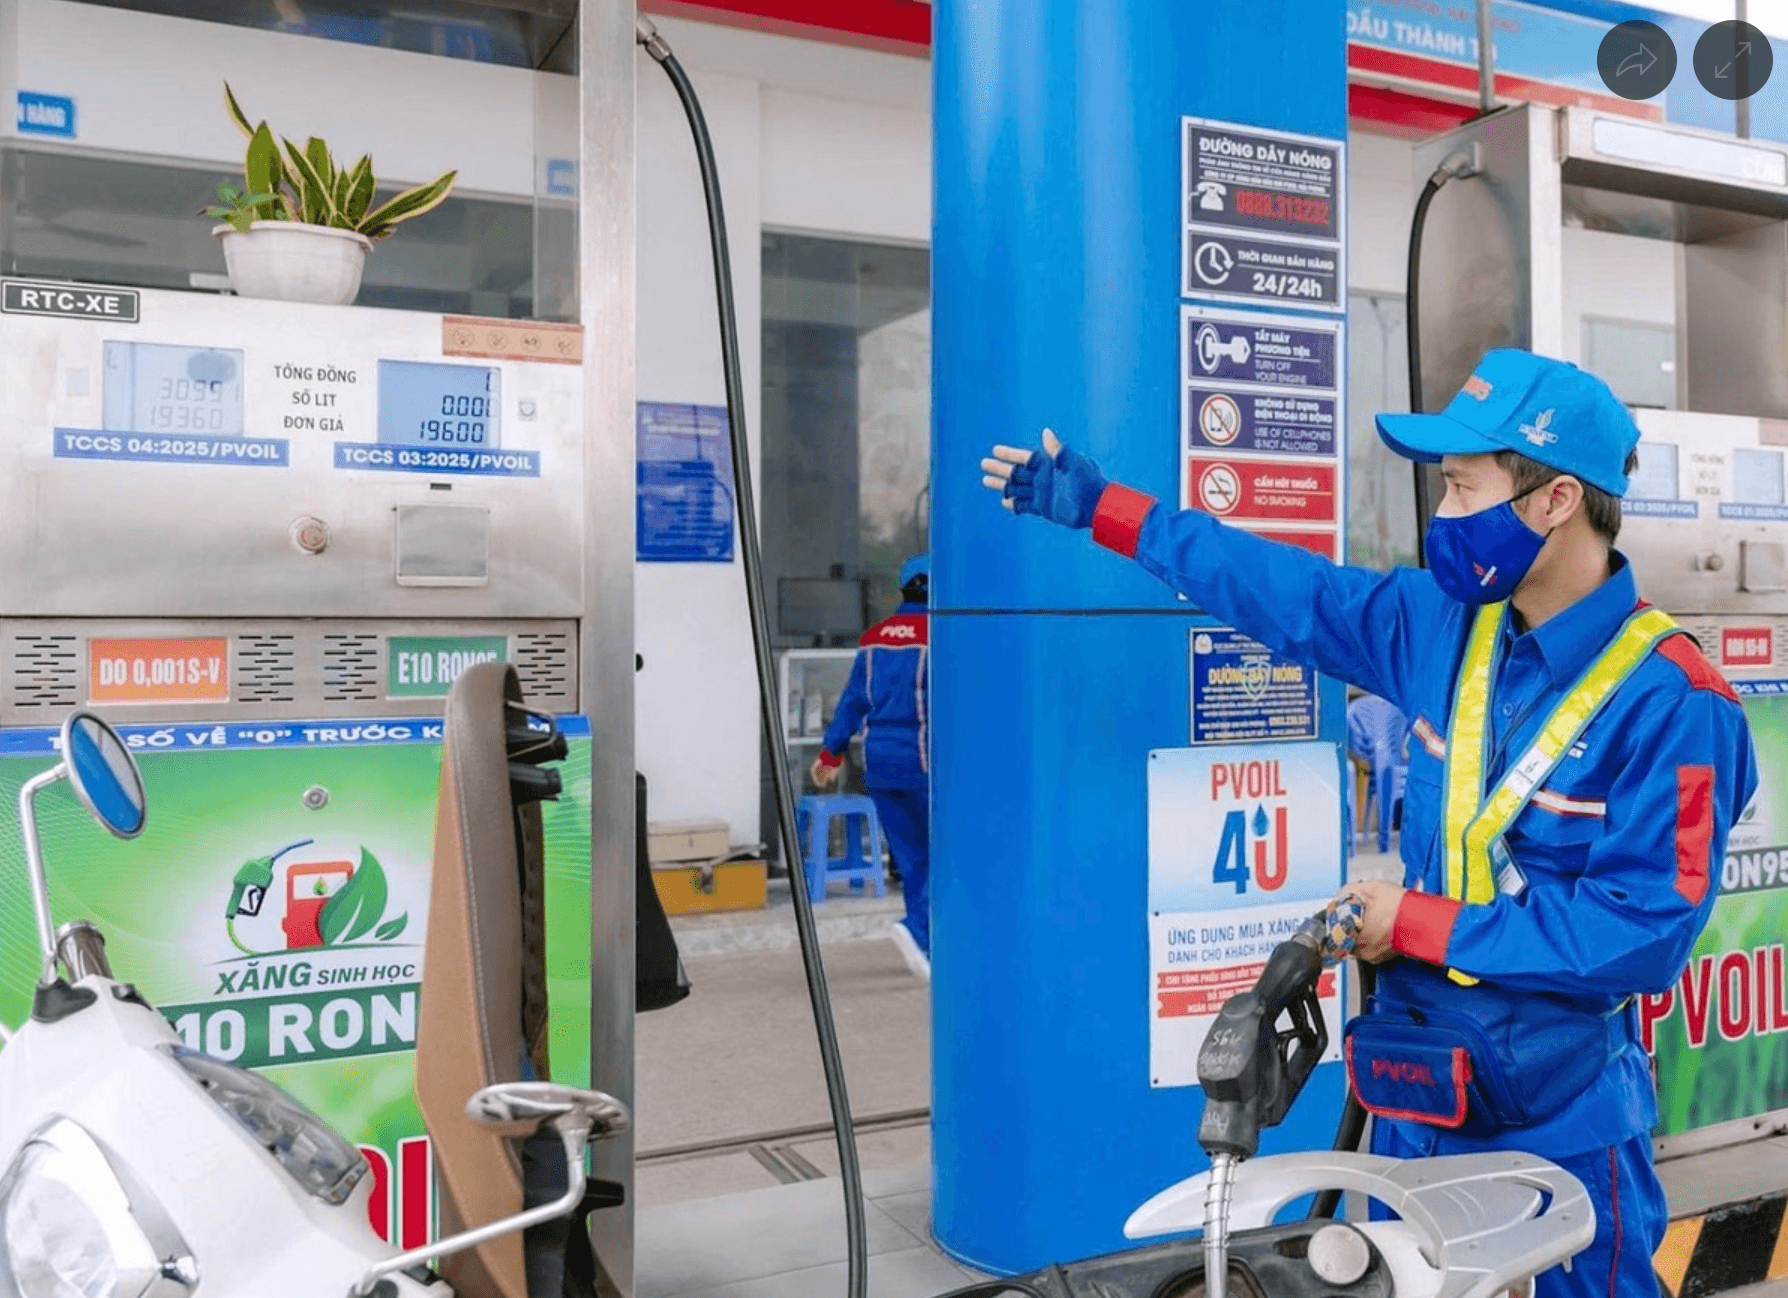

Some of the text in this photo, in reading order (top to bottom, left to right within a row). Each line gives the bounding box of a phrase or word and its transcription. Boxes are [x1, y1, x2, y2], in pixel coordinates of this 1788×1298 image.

[1199, 137, 1253, 158] ĐƯỜNG
[1257, 143, 1286, 163] DÂY
[1289, 150, 1332, 170] NÓNG
[1253, 272, 1322, 298] 24/24h
[21, 289, 120, 314] RTC-XE
[274, 362, 357, 383] TỔNG ĐỒNG
[292, 388, 337, 406] SỐ LIT
[151, 405, 223, 430] 19360
[283, 415, 315, 430] ĐƠN
[420, 420, 485, 443] 19600
[64, 434, 280, 460] TCCS 04:2025/PVOIL
[343, 448, 532, 470] TCCS 03:2025/PVOIL
[100, 657, 221, 687] DO 0,001S-V
[398, 651, 432, 684] E10
[127, 729, 175, 747] SỐ
[185, 727, 227, 745] VỀ
[302, 724, 412, 742] TRƯỚC
[1211, 760, 1287, 801] PVOIL
[1239, 922, 1264, 939] MUA
[1201, 948, 1222, 962] CHO
[214, 961, 416, 995] XĂNG SINH HỌC
[1640, 946, 1788, 1054] PVOIL
[172, 991, 417, 1062] 10 RON
